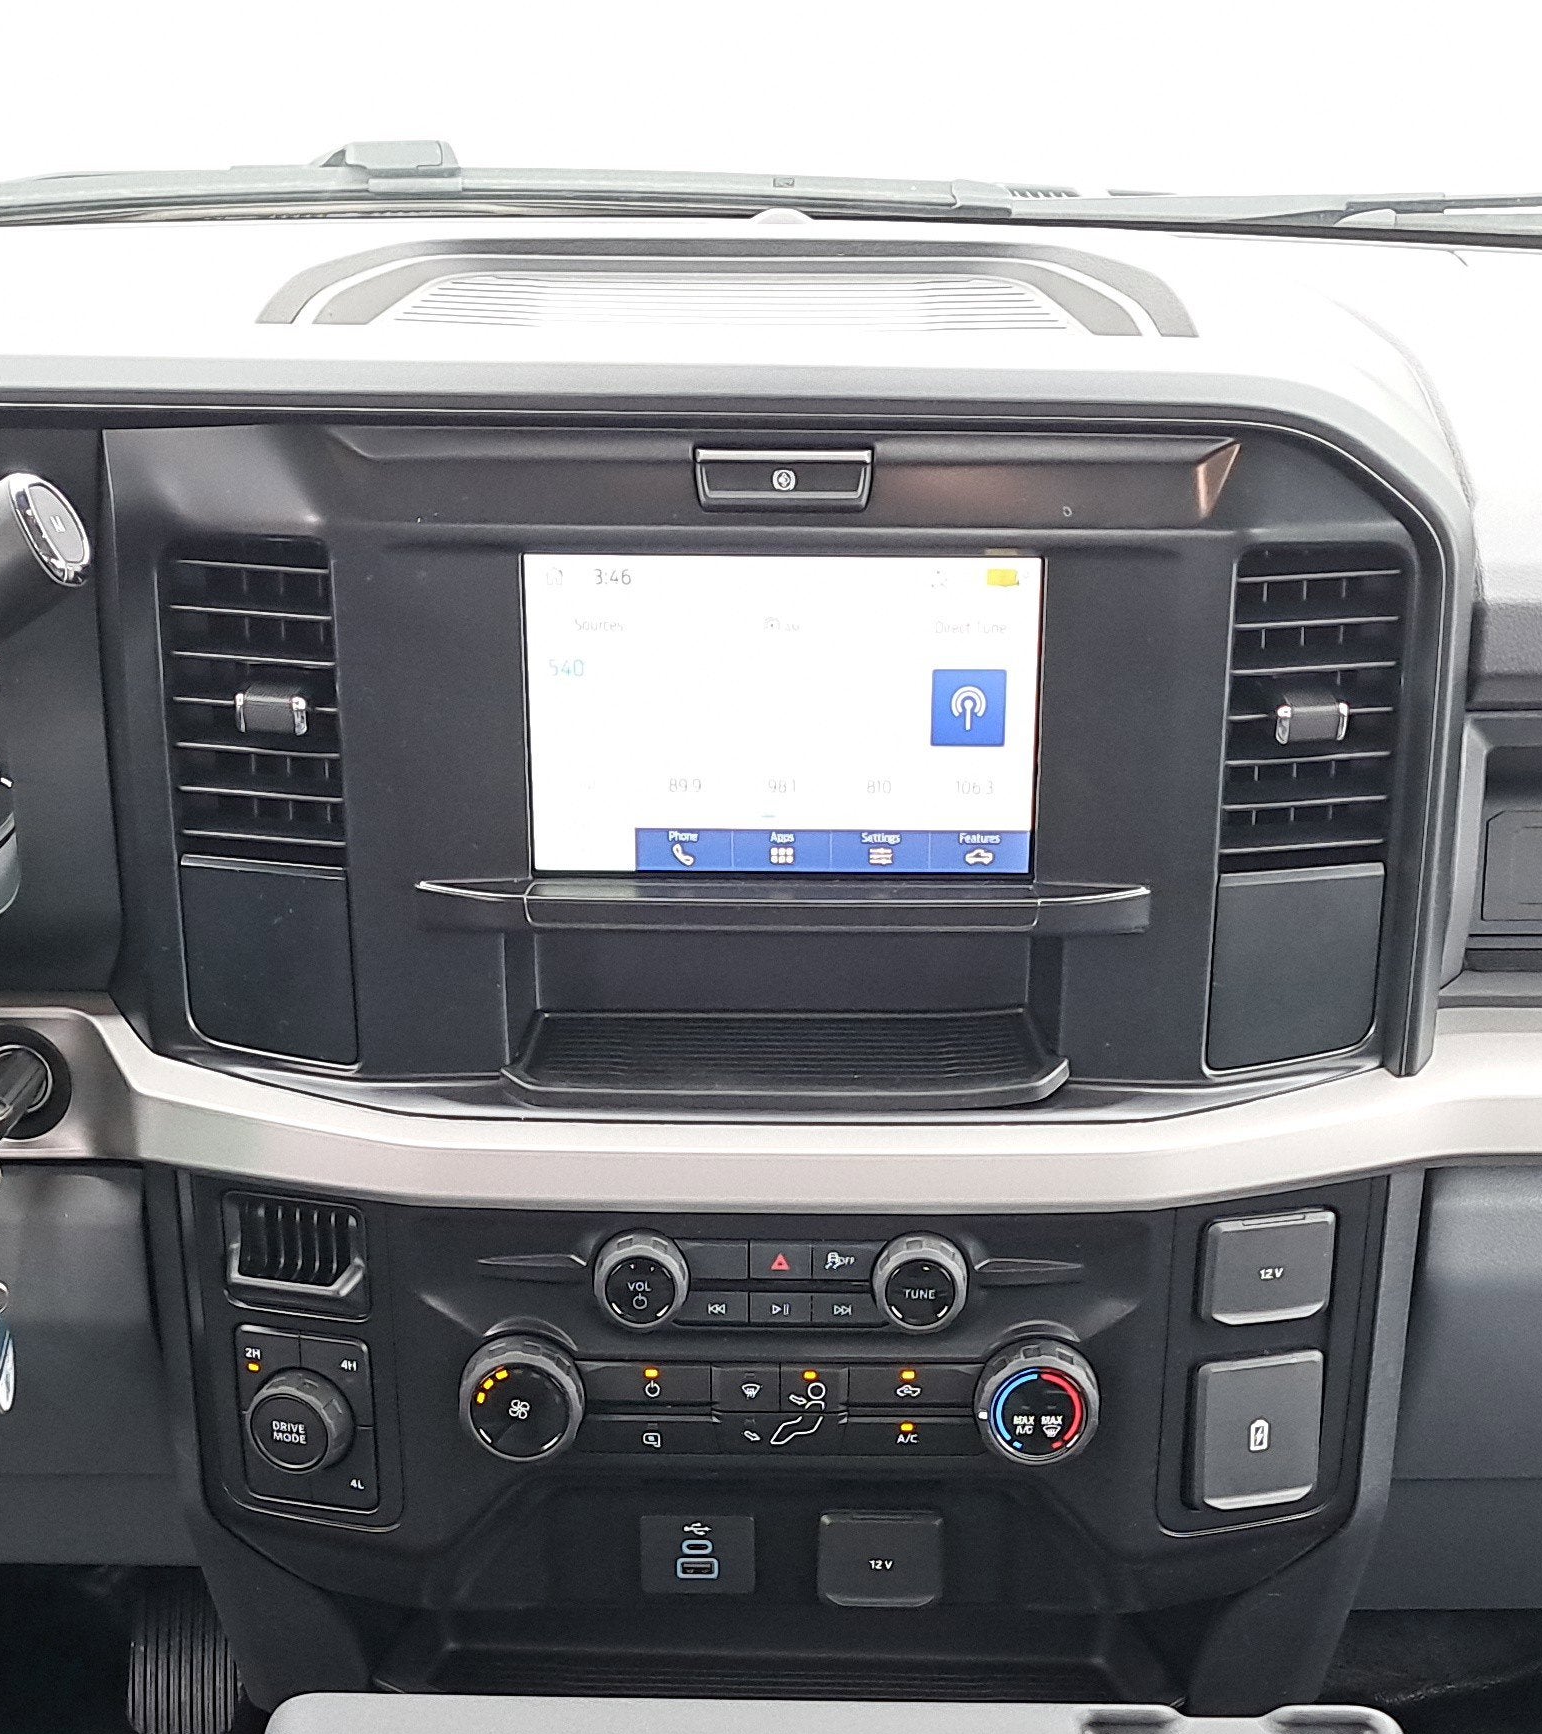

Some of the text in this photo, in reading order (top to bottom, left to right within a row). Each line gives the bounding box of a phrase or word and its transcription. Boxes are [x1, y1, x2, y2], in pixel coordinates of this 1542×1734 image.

[594, 568, 632, 585] 3:46
[668, 830, 699, 843] Phone
[770, 831, 795, 844] Apps
[861, 832, 901, 845] Settings
[958, 832, 1001, 844] Features
[627, 1281, 653, 1292] VOL
[902, 1288, 936, 1300] TUNE
[245, 1347, 261, 1360] 2H
[340, 1359, 358, 1372] 4H
[271, 1419, 305, 1434] DRIVE
[272, 1431, 307, 1445] MODE
[896, 1433, 918, 1445] A/C
[349, 1479, 365, 1491] 4L
